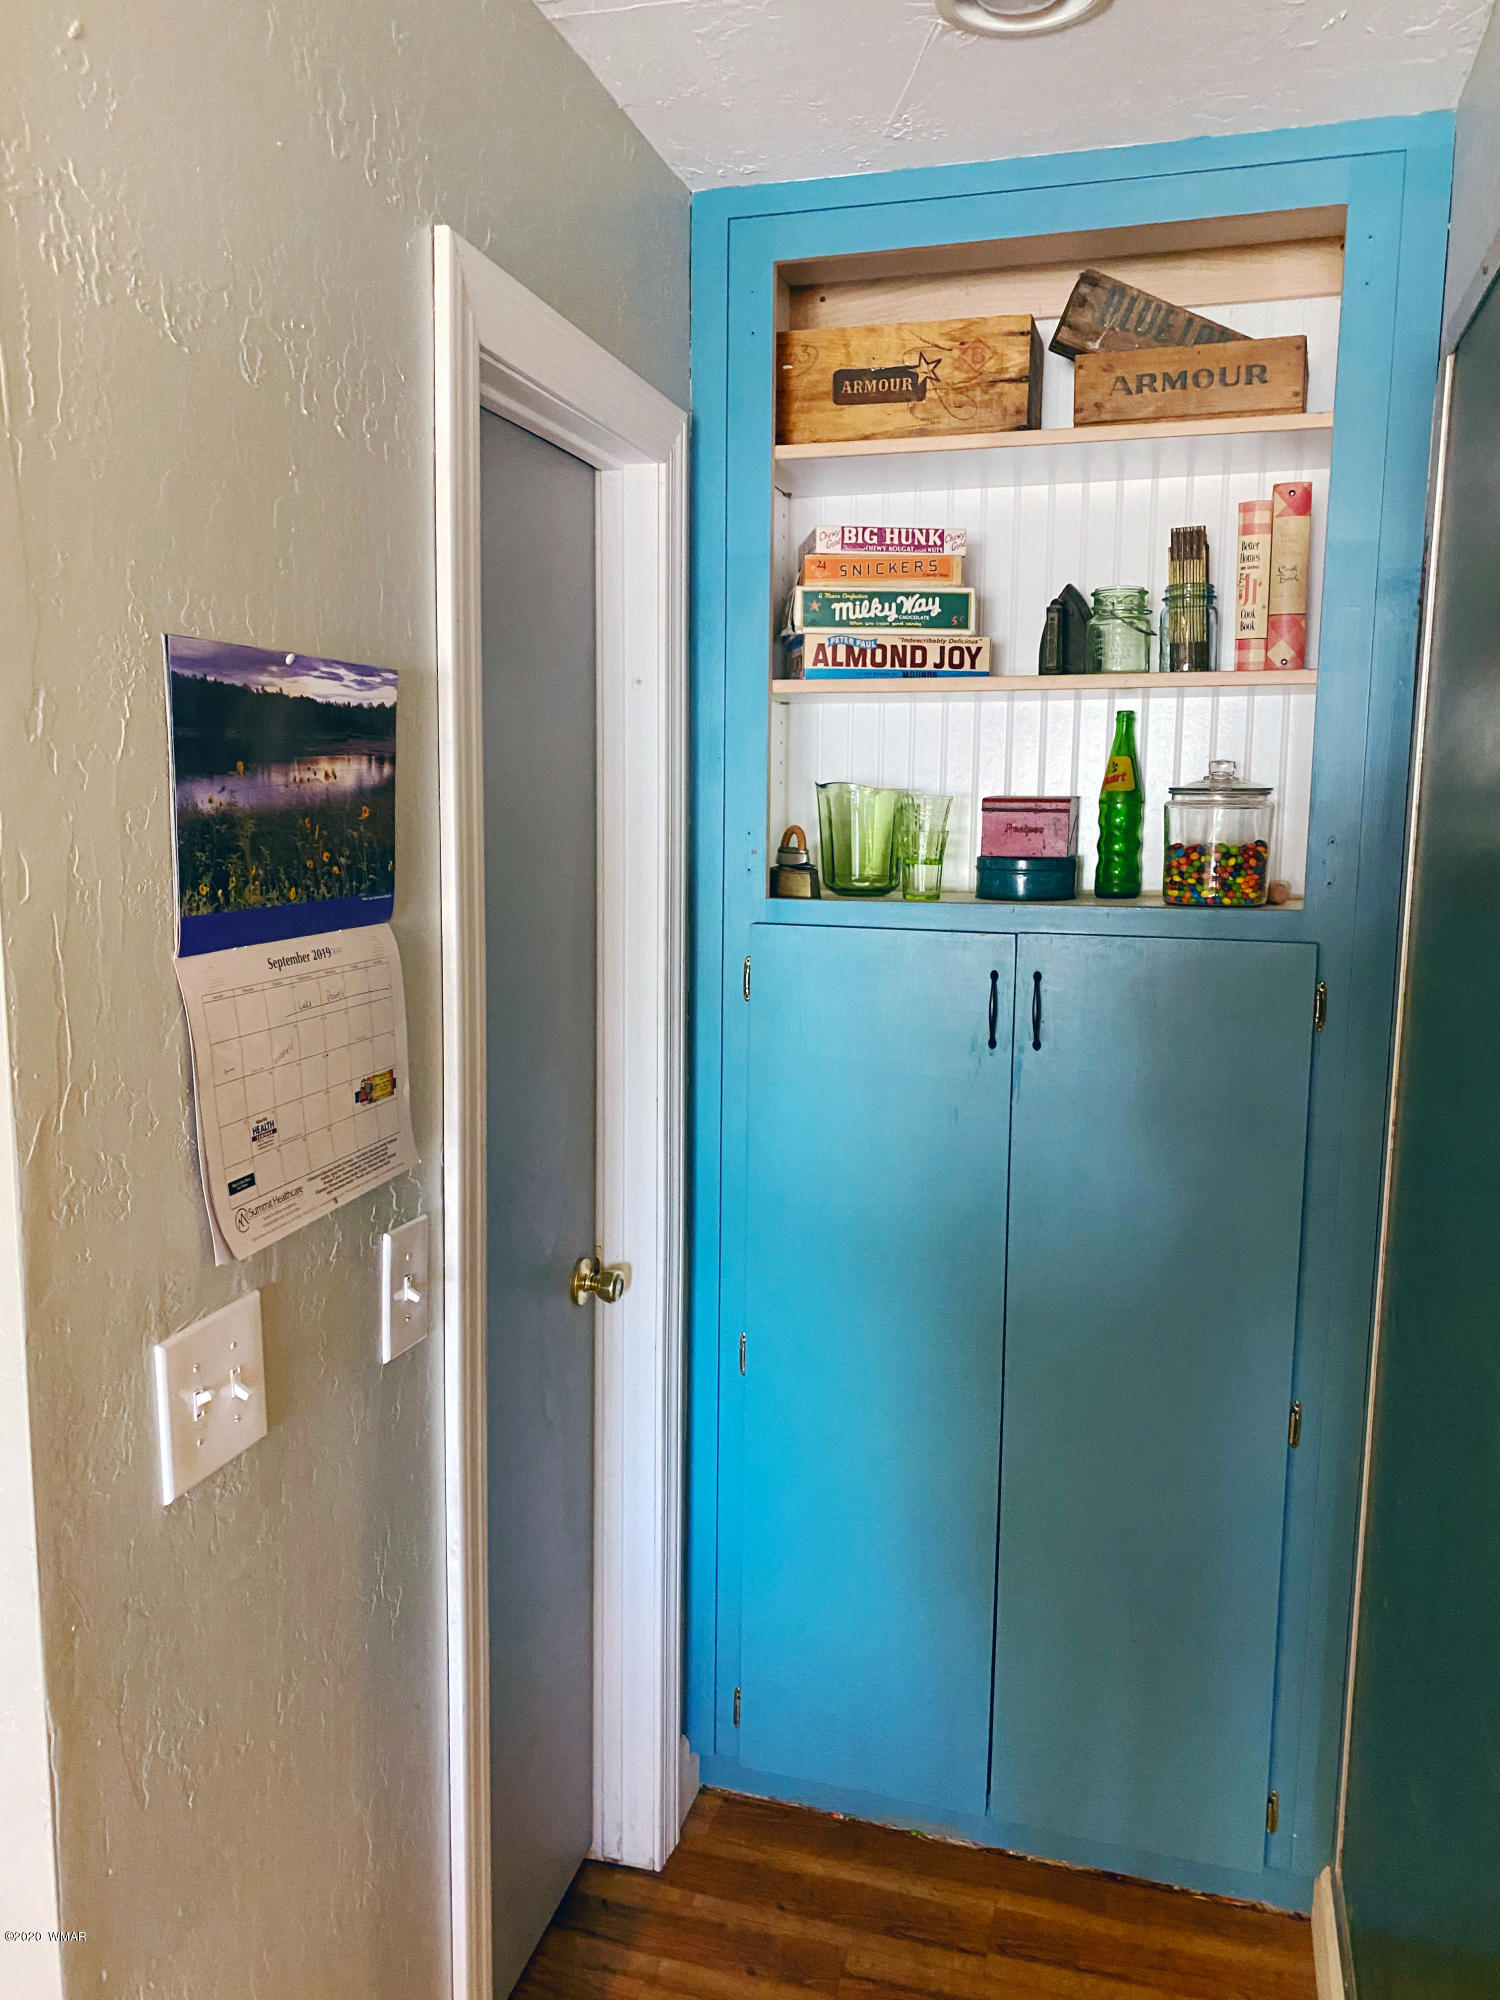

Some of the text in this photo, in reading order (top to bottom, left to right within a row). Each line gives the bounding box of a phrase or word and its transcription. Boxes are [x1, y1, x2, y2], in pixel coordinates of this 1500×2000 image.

[841, 377, 913, 395] ARMOUR
[1109, 364, 1268, 396] ARMOUR
[843, 527, 943, 546] BIG HUNK
[1241, 540, 1260, 551] Better
[1240, 552, 1261, 563] Homes
[840, 560, 937, 577] SNICKERS
[831, 593, 942, 622] Milky Way
[1240, 608, 1256, 619] Cook
[1240, 620, 1256, 632] Book
[830, 636, 877, 648] PETER PAUL
[812, 643, 983, 670] ALMOND JOY
[1004, 823, 1045, 837] Recipes
[267, 946, 332, 971] September 2019
[252, 1119, 276, 1136] HEALTH
[248, 1200, 274, 1218] Summit
[272, 1185, 304, 1207] Healthcare
